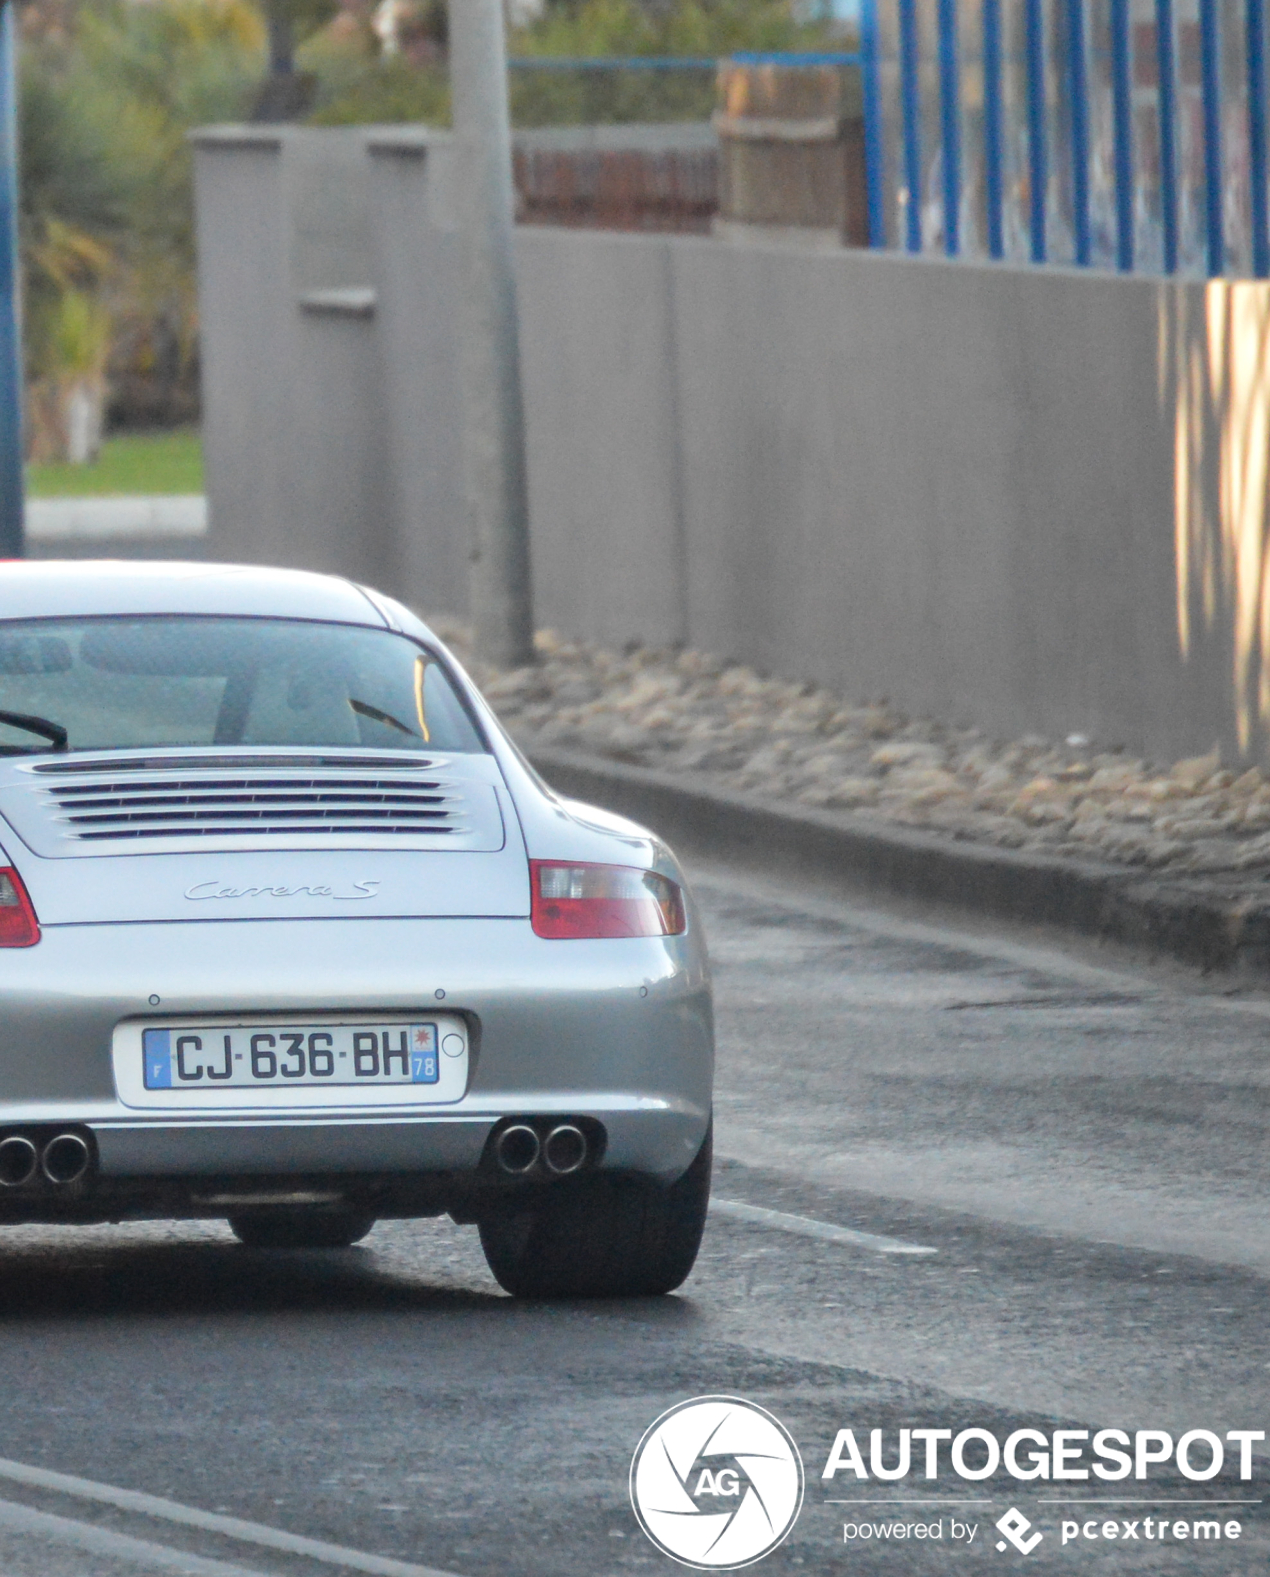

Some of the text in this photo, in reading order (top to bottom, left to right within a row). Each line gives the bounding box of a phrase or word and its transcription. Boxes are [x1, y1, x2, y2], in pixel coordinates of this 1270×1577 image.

[184, 880, 382, 901] Carrera S
[413, 1057, 435, 1077] 78
